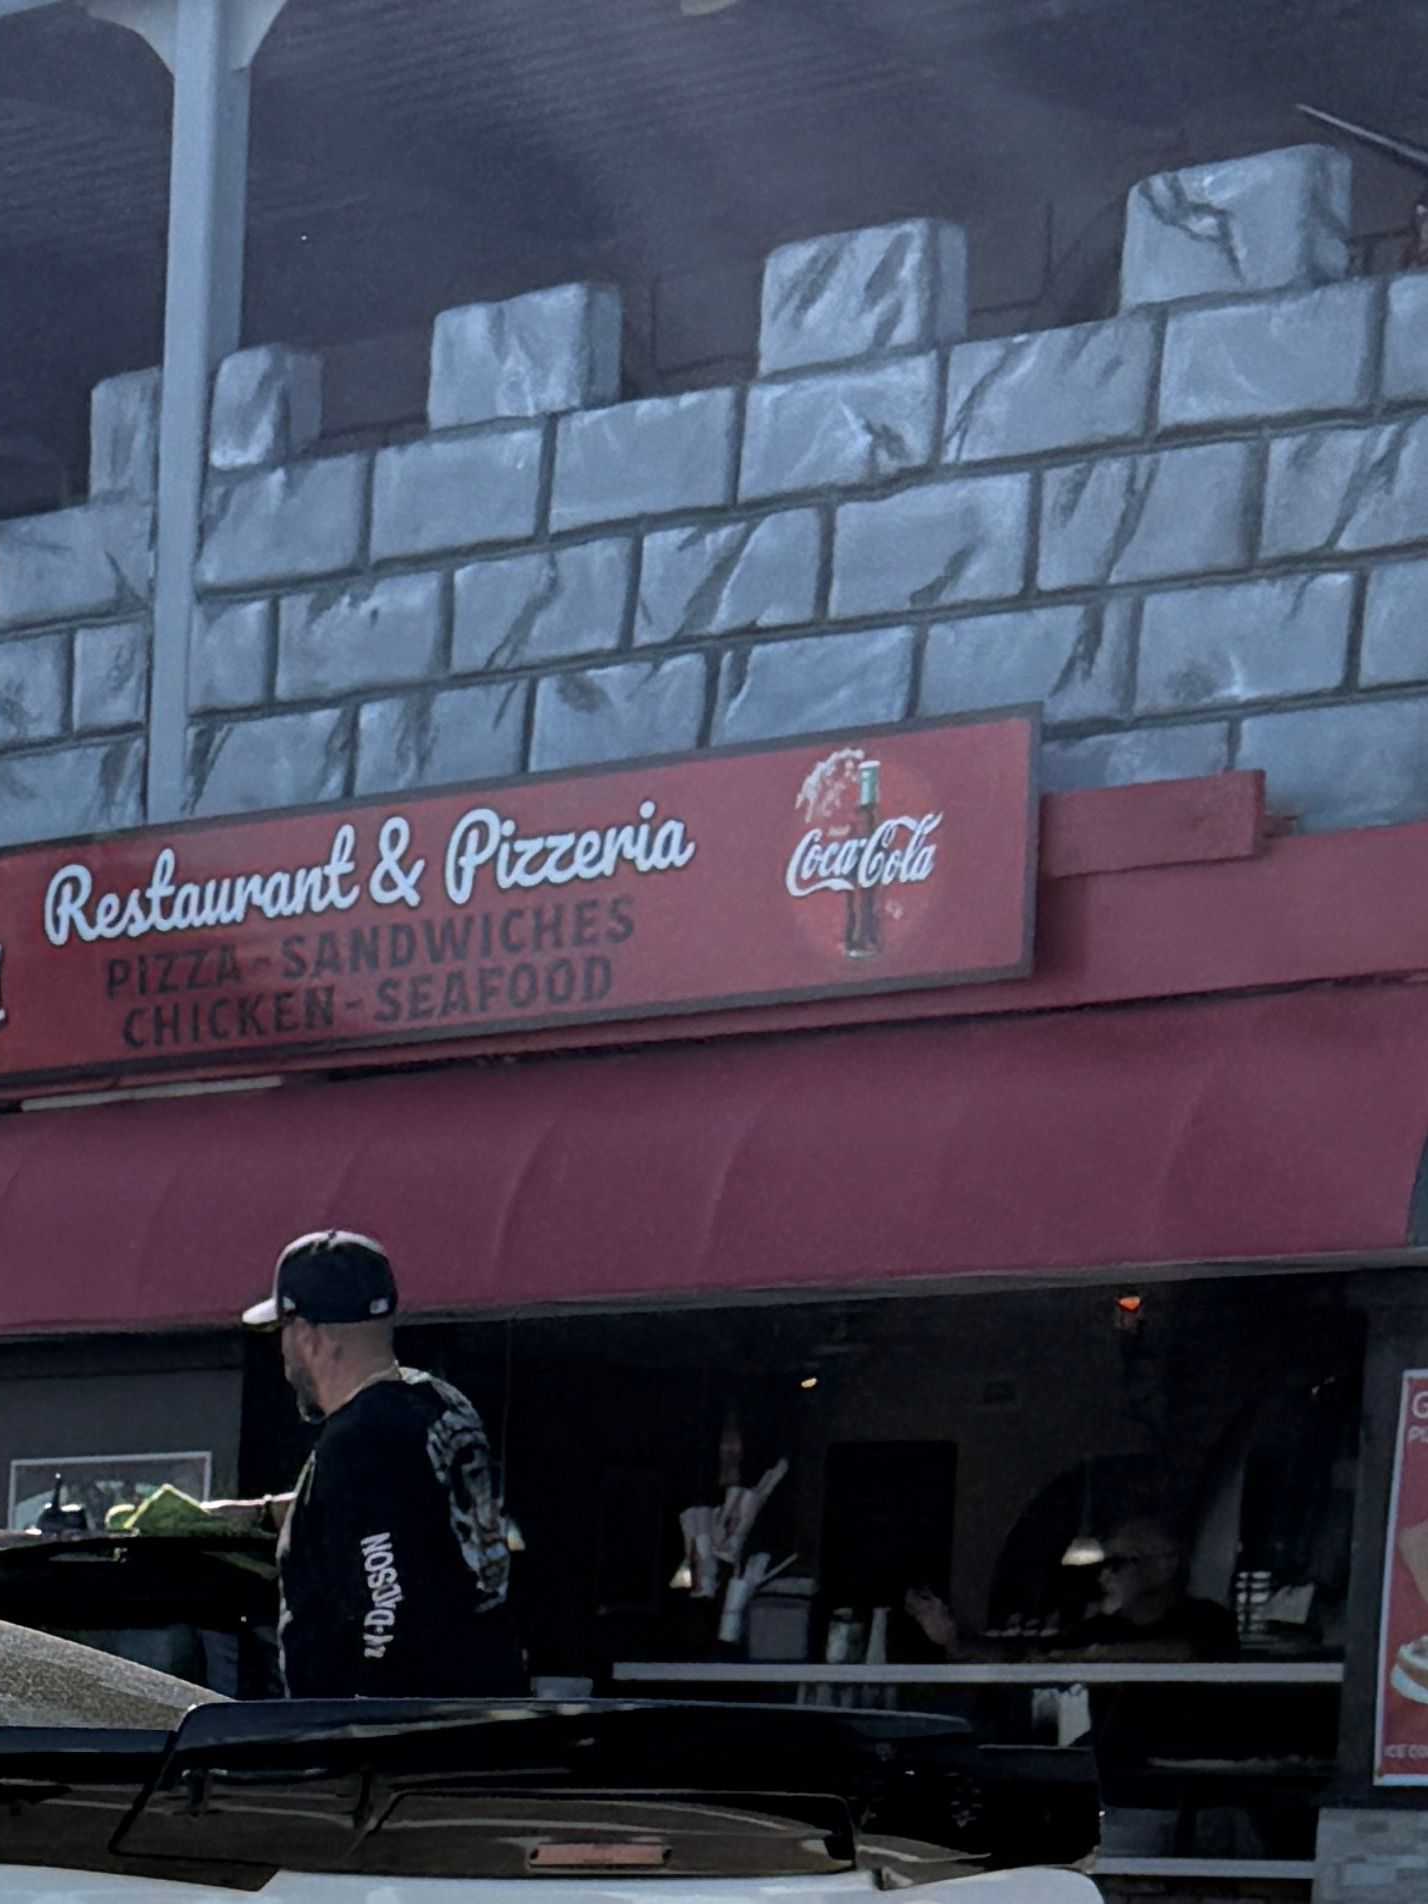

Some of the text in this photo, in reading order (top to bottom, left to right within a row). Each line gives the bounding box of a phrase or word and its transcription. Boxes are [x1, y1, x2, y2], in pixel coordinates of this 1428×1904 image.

[44, 801, 696, 946] Restaurant & Pizzeria
[785, 810, 944, 897] Coca-Cola
[105, 945, 243, 1002] PIZZA
[280, 897, 636, 980] SANDWICHES
[121, 985, 337, 1049] CHICKEN
[374, 957, 614, 1024] SEAFOOD
